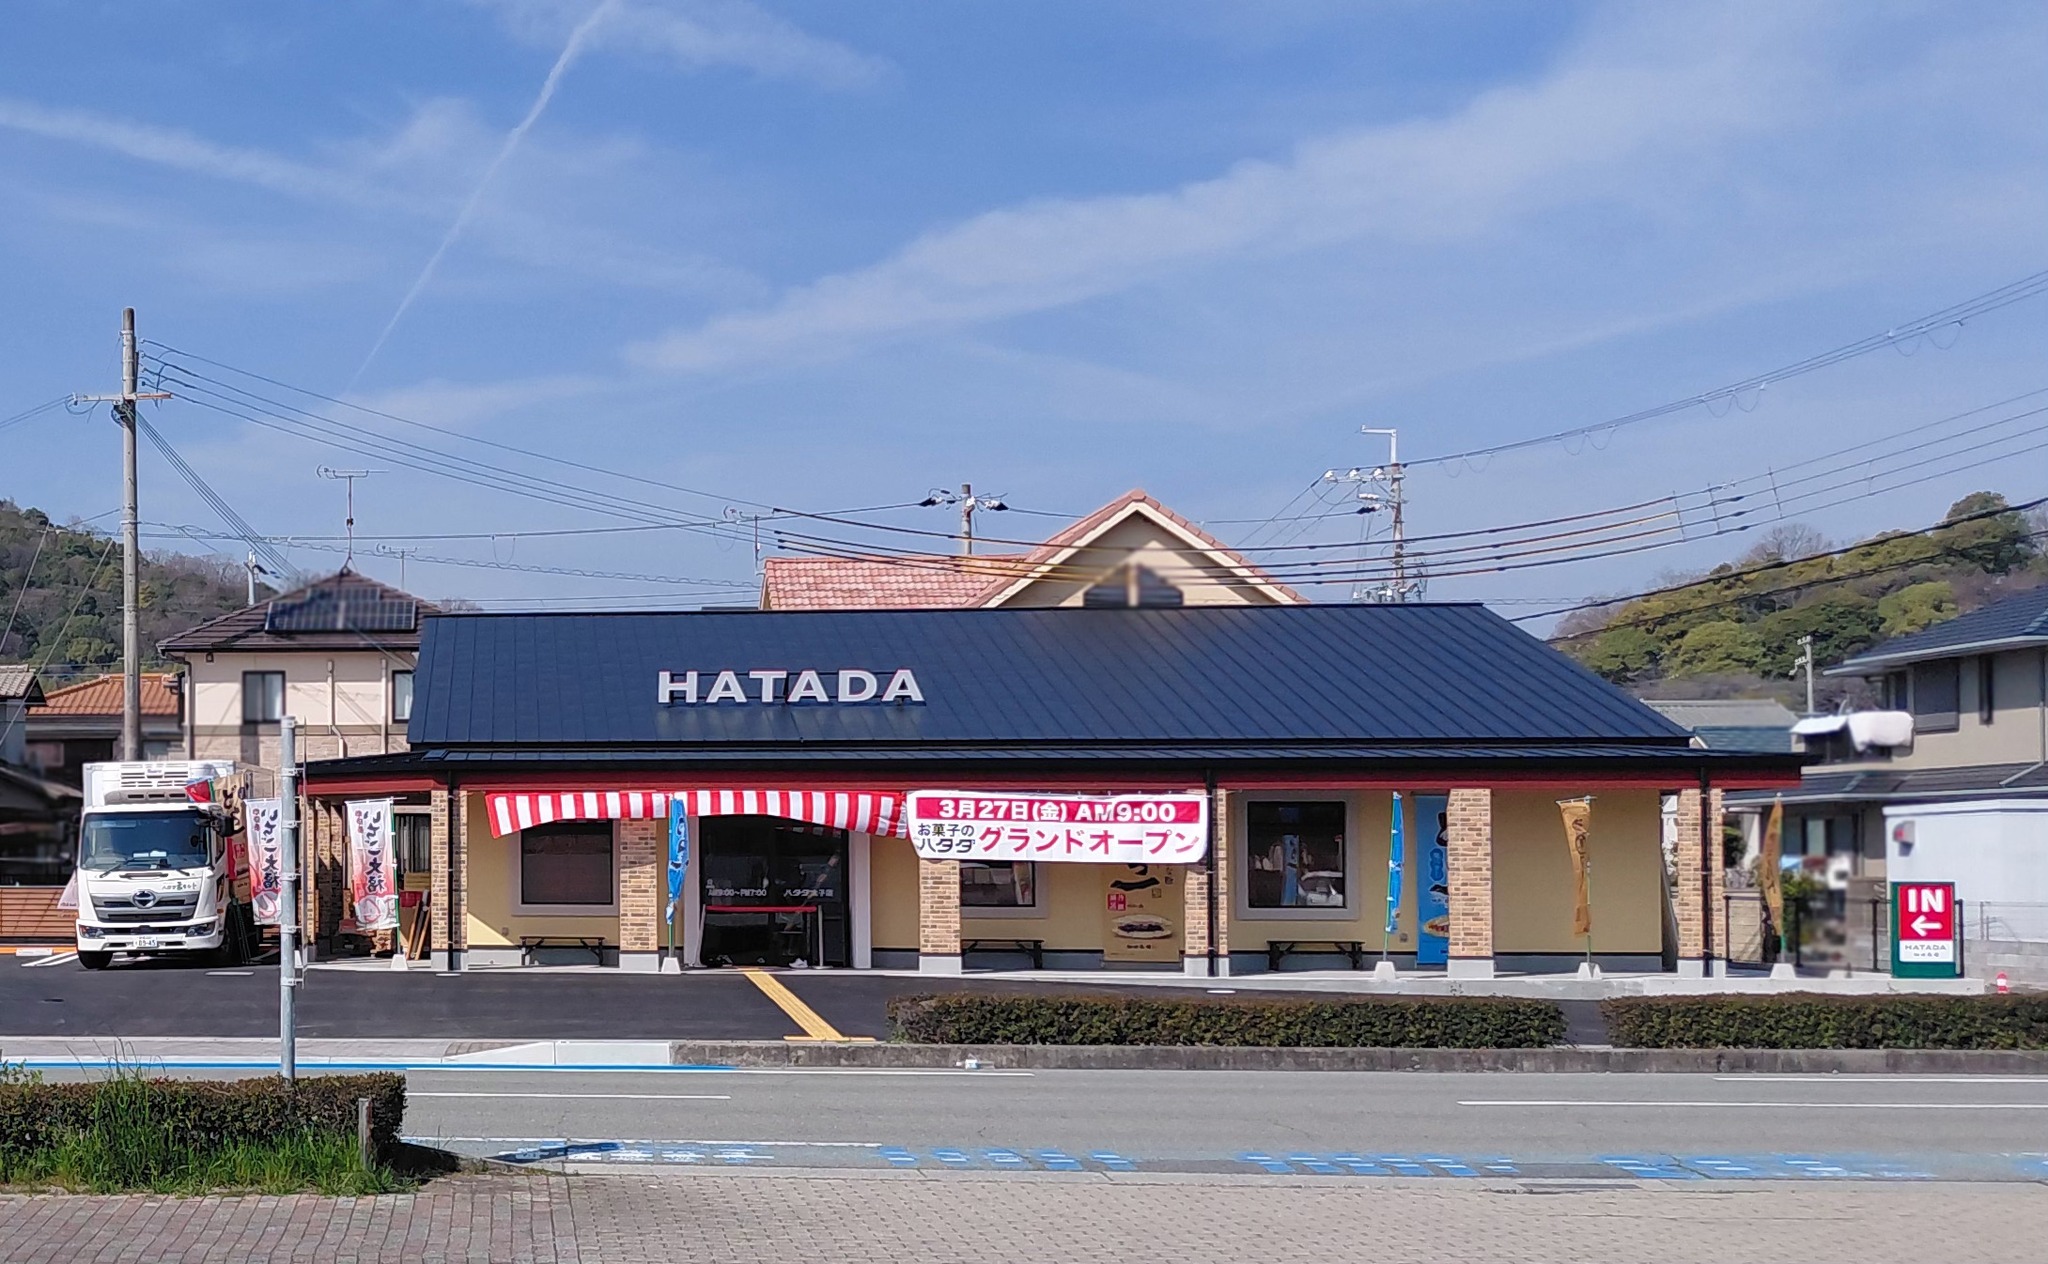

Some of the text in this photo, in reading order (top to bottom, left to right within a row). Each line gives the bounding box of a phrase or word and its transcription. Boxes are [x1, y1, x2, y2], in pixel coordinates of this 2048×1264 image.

[658, 670, 925, 703] HATADA
[939, 800, 1176, 823] 3月27日(金) AM9:00
[917, 823, 975, 837] お菓子の
[979, 826, 1199, 855] グランドオープン
[917, 839, 973, 854] ハタダ
[1908, 888, 1945, 913] IN
